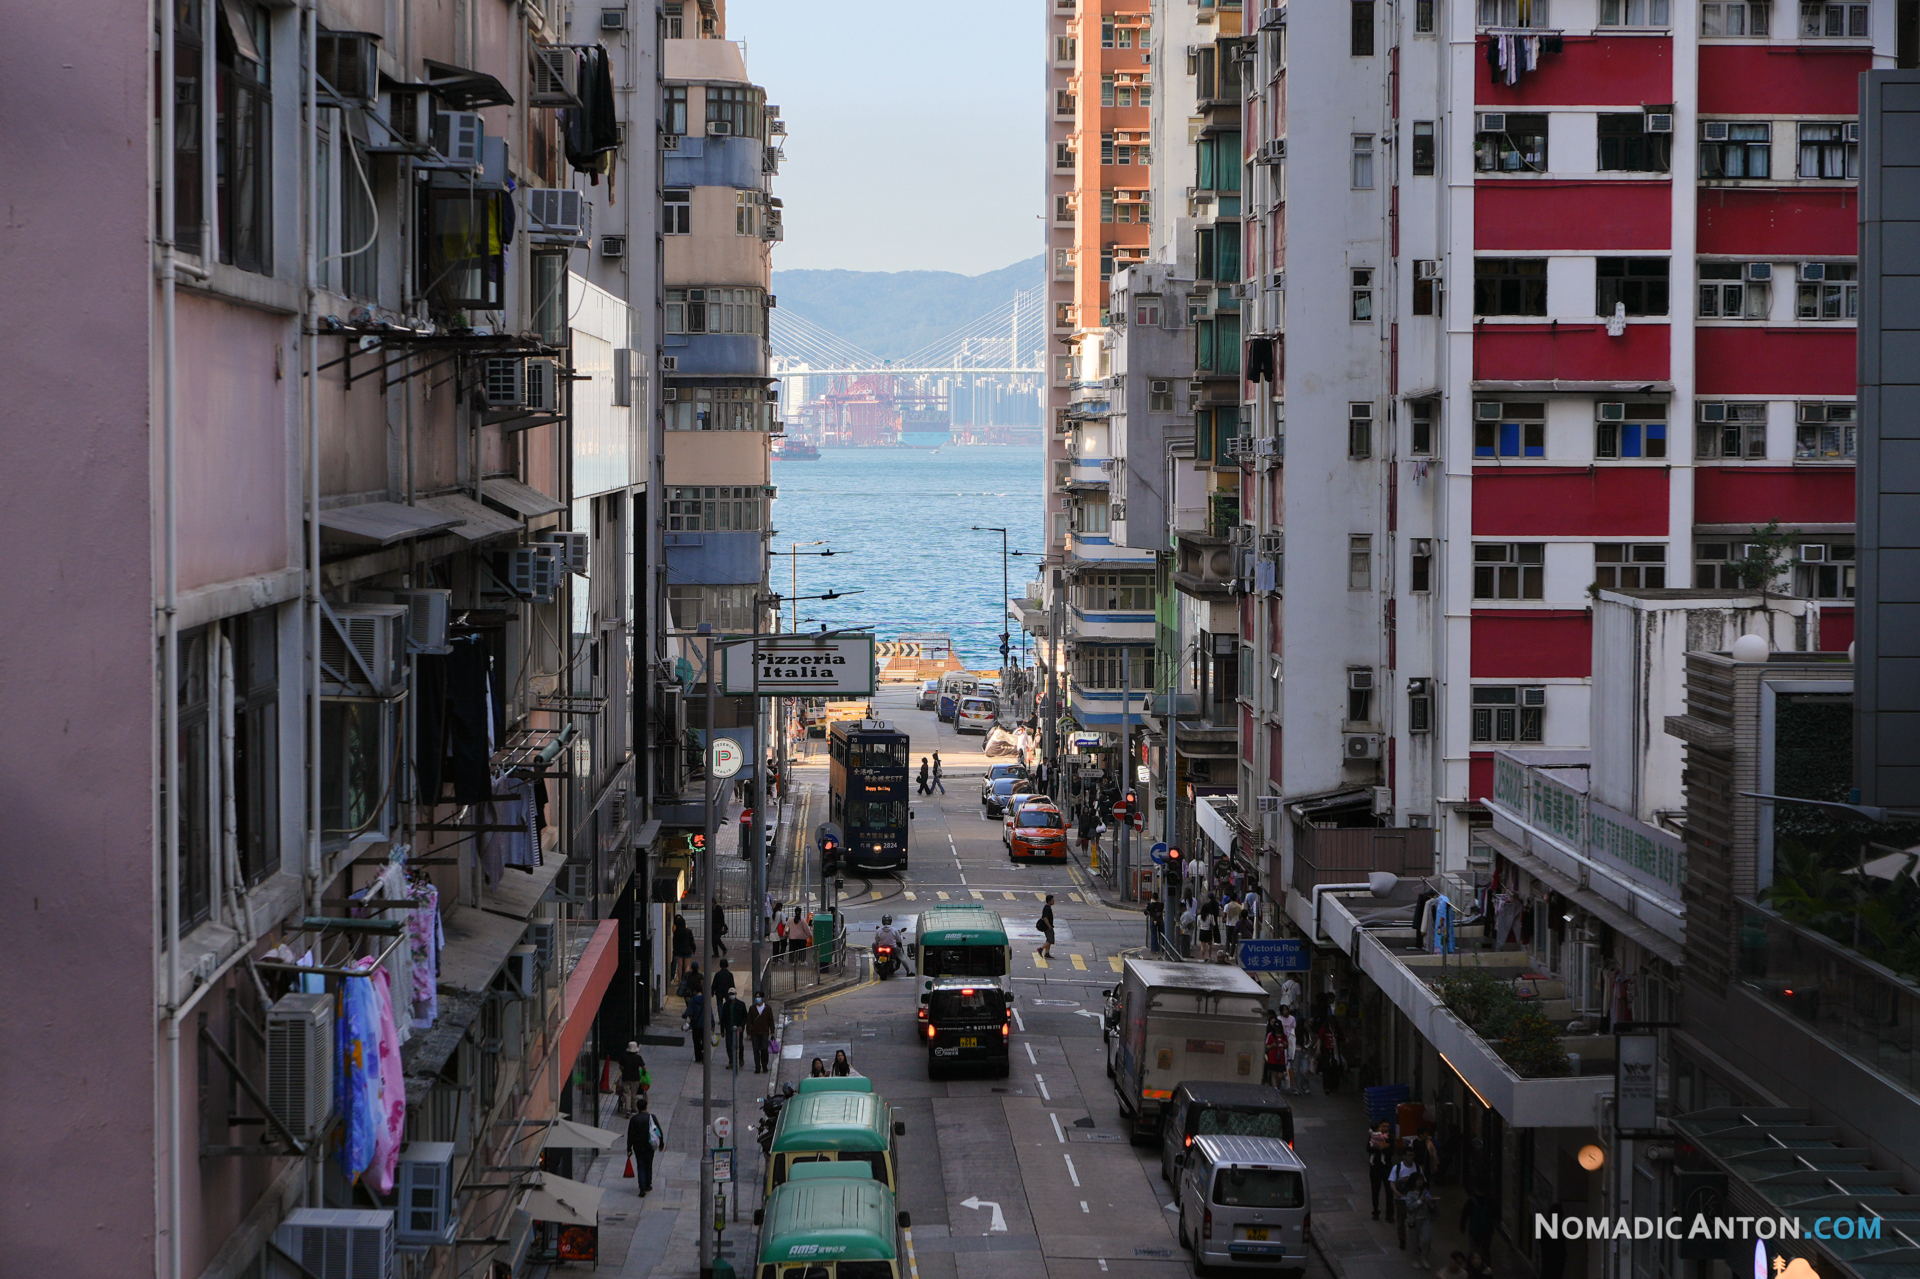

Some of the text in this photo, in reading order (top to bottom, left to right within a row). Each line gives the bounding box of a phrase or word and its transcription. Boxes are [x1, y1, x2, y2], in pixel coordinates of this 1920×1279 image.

[751, 653, 846, 665] Pizzeria
[763, 666, 834, 678] Italia
[871, 720, 885, 729] 70
[1247, 944, 1300, 952] Victoria Roa
[1247, 955, 1297, 967] 域多利道
[788, 1244, 819, 1255] AMS
